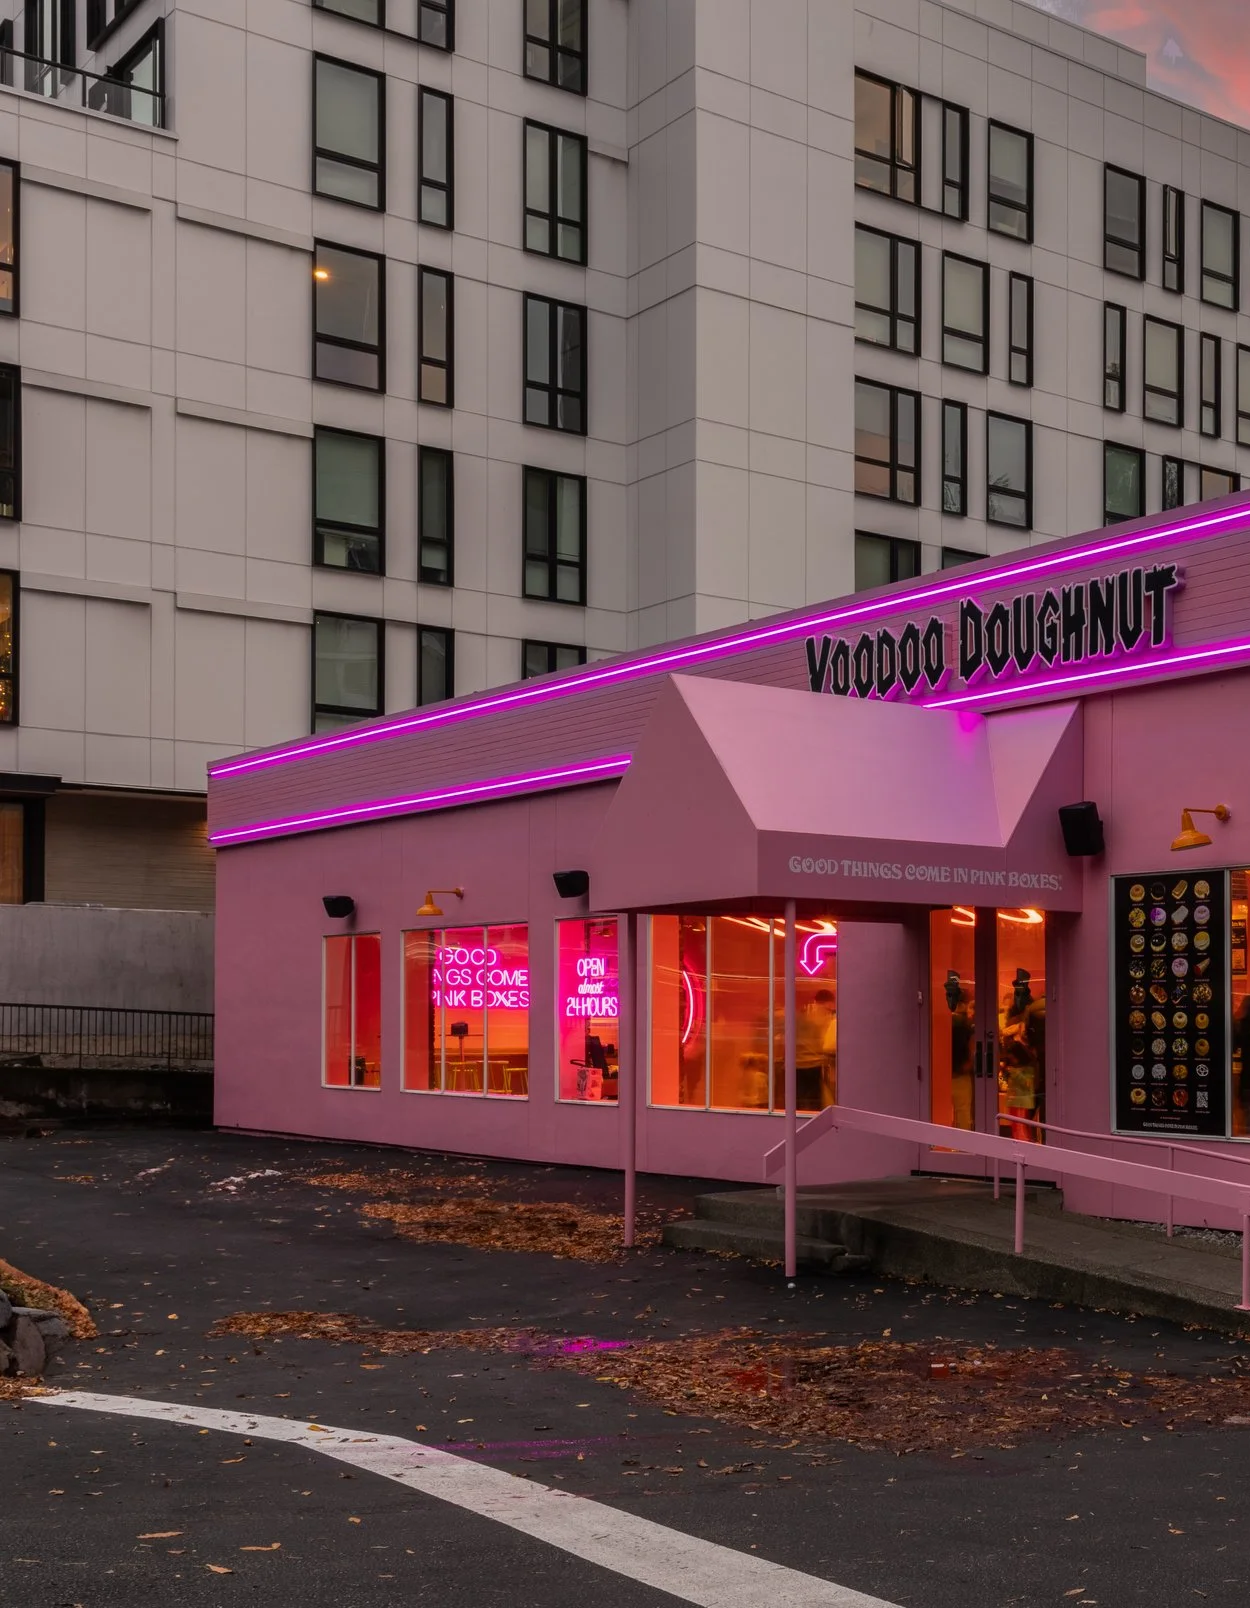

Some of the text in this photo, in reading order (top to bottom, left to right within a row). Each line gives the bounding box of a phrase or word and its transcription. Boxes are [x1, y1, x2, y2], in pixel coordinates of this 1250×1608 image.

[805, 563, 1180, 700] VOODOO DOUGHNUT
[788, 855, 839, 875] GOOD
[840, 859, 903, 880] THINGS
[905, 863, 951, 883] COME
[953, 867, 969, 884] IN
[970, 869, 1007, 886] PINK
[439, 947, 498, 966] GOOD
[576, 957, 605, 977] OPEN
[475, 969, 529, 987] COME
[577, 977, 605, 995] almost
[470, 989, 530, 1008] BOXES
[566, 996, 619, 1017] 24 HOURS
